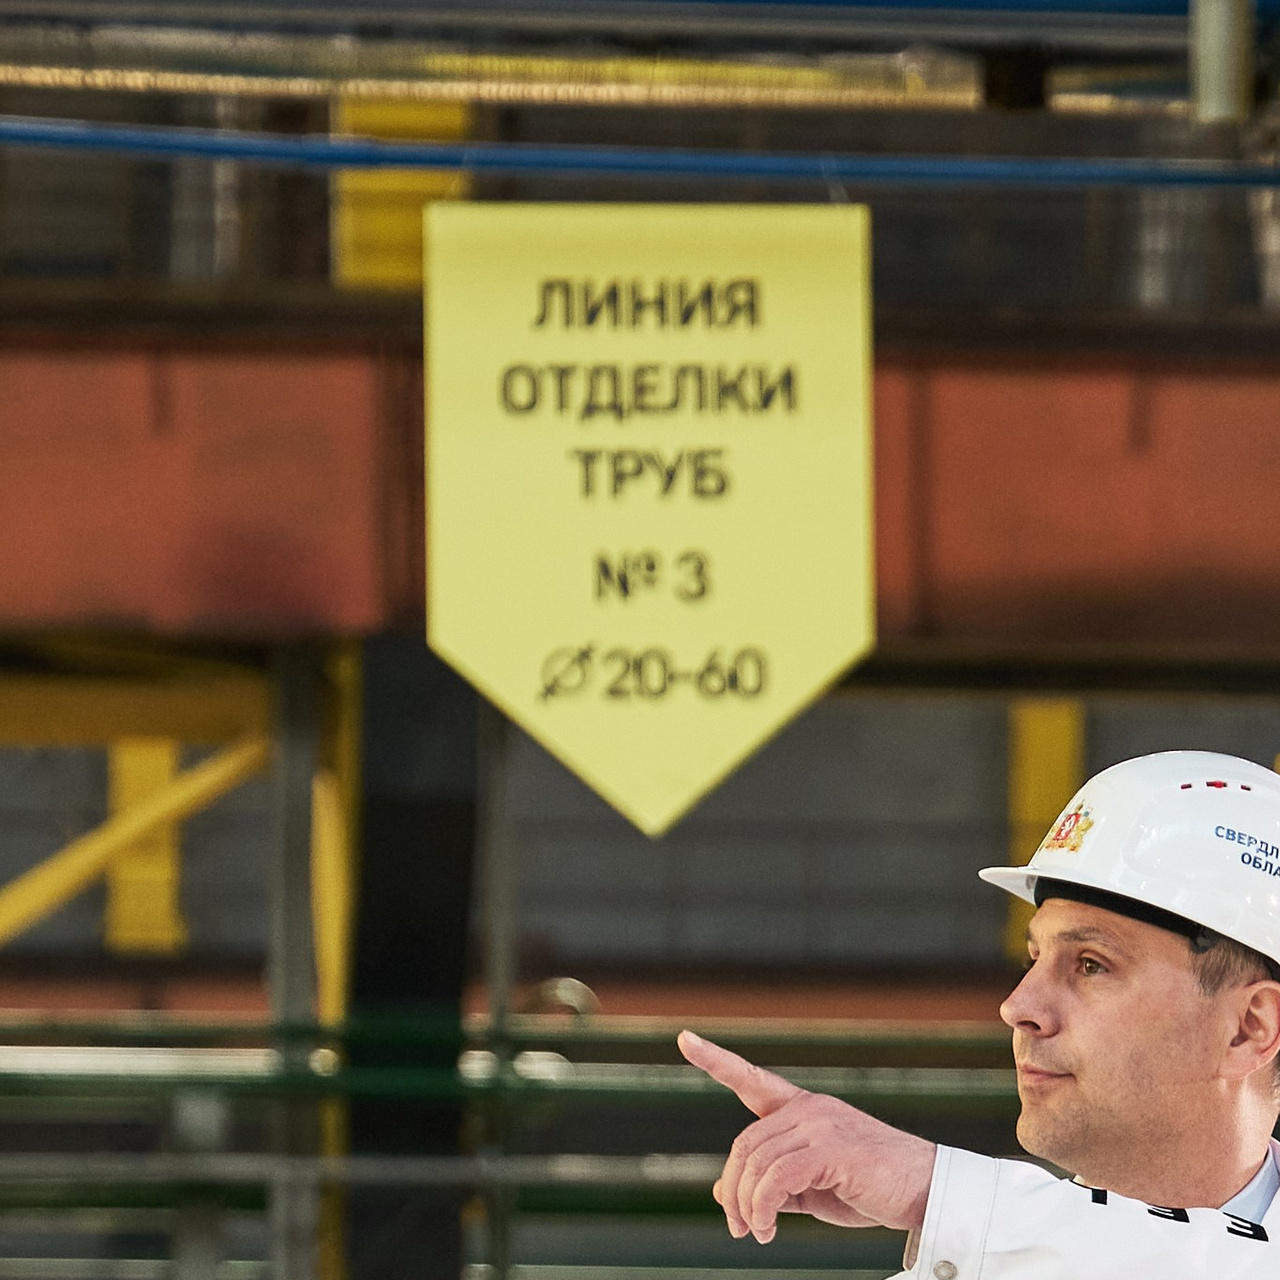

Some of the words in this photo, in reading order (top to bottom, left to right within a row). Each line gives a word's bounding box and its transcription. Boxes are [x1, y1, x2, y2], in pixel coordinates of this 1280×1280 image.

[533, 276, 762, 331] ЛИНИЯ
[499, 362, 799, 423] ОТДЕЛКИ
[570, 447, 732, 500] ТРУБ
